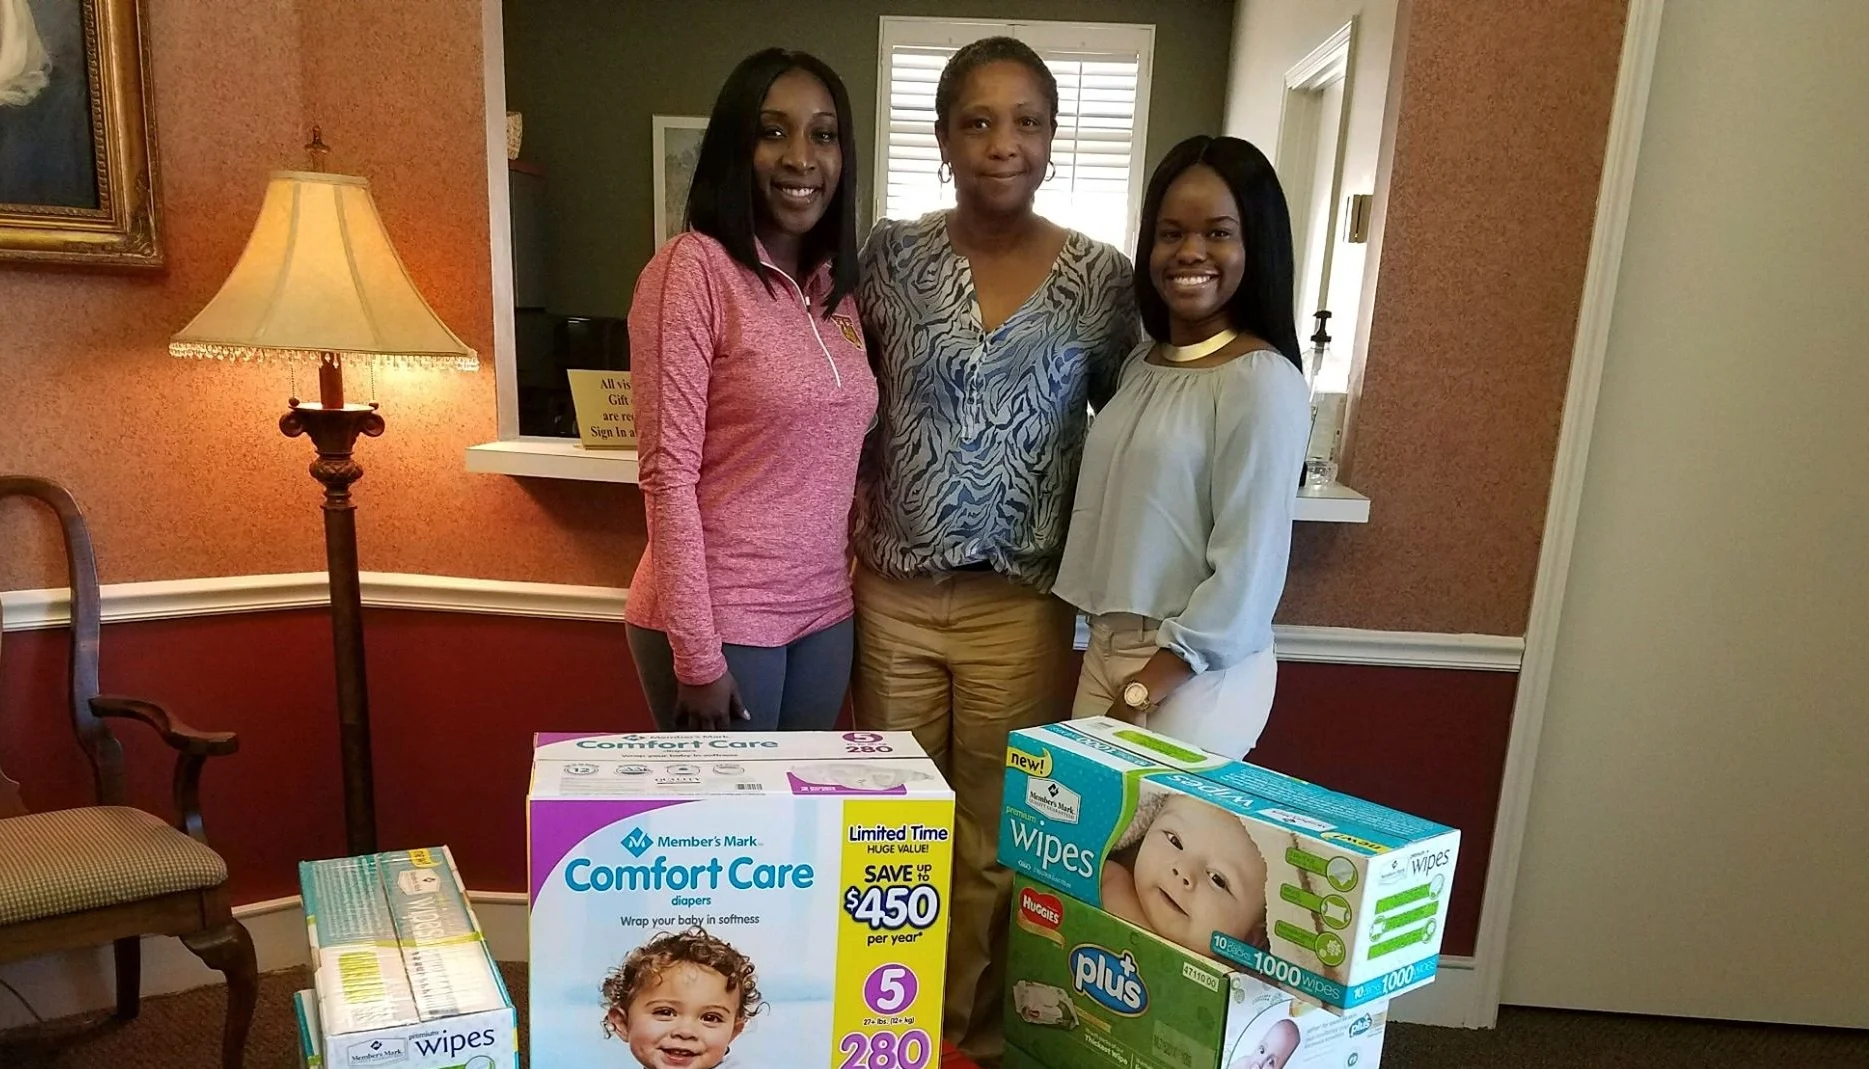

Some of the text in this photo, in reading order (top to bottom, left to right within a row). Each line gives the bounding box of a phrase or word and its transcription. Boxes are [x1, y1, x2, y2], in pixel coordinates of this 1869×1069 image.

[600, 378, 615, 390] All
[608, 394, 629, 406] Gift
[603, 412, 618, 421] are
[590, 426, 613, 440] Sign
[616, 427, 627, 437] In
[576, 740, 779, 750] Comfort Care
[853, 732, 874, 743] 5
[845, 745, 894, 753] 280
[1010, 752, 1045, 775] new!
[1030, 791, 1075, 815] Member's Mark
[1006, 806, 1037, 823] premium
[849, 825, 948, 841] Limited Time
[657, 836, 758, 847] Member's Mark
[867, 844, 929, 854] HUGE VALUE!
[1010, 818, 1095, 878] wipes
[1411, 849, 1451, 876] wipes
[564, 856, 815, 892] Comfort Care
[864, 864, 932, 883] SAVE up
[917, 873, 930, 882] to
[671, 895, 711, 908] diapers
[845, 886, 938, 927] $450
[1023, 894, 1060, 925] HUGGIES
[620, 913, 760, 929] Wrap your baby in softness
[867, 935, 888, 947] per
[1214, 935, 1227, 950] 10
[1301, 975, 1341, 1000] wipes
[1076, 952, 1142, 1009] plus
[877, 968, 906, 1010] 5
[1354, 985, 1365, 1000] 10
[415, 1028, 496, 1058] wipes
[839, 1029, 932, 1069] 280
[384, 1049, 402, 1058] Mark
